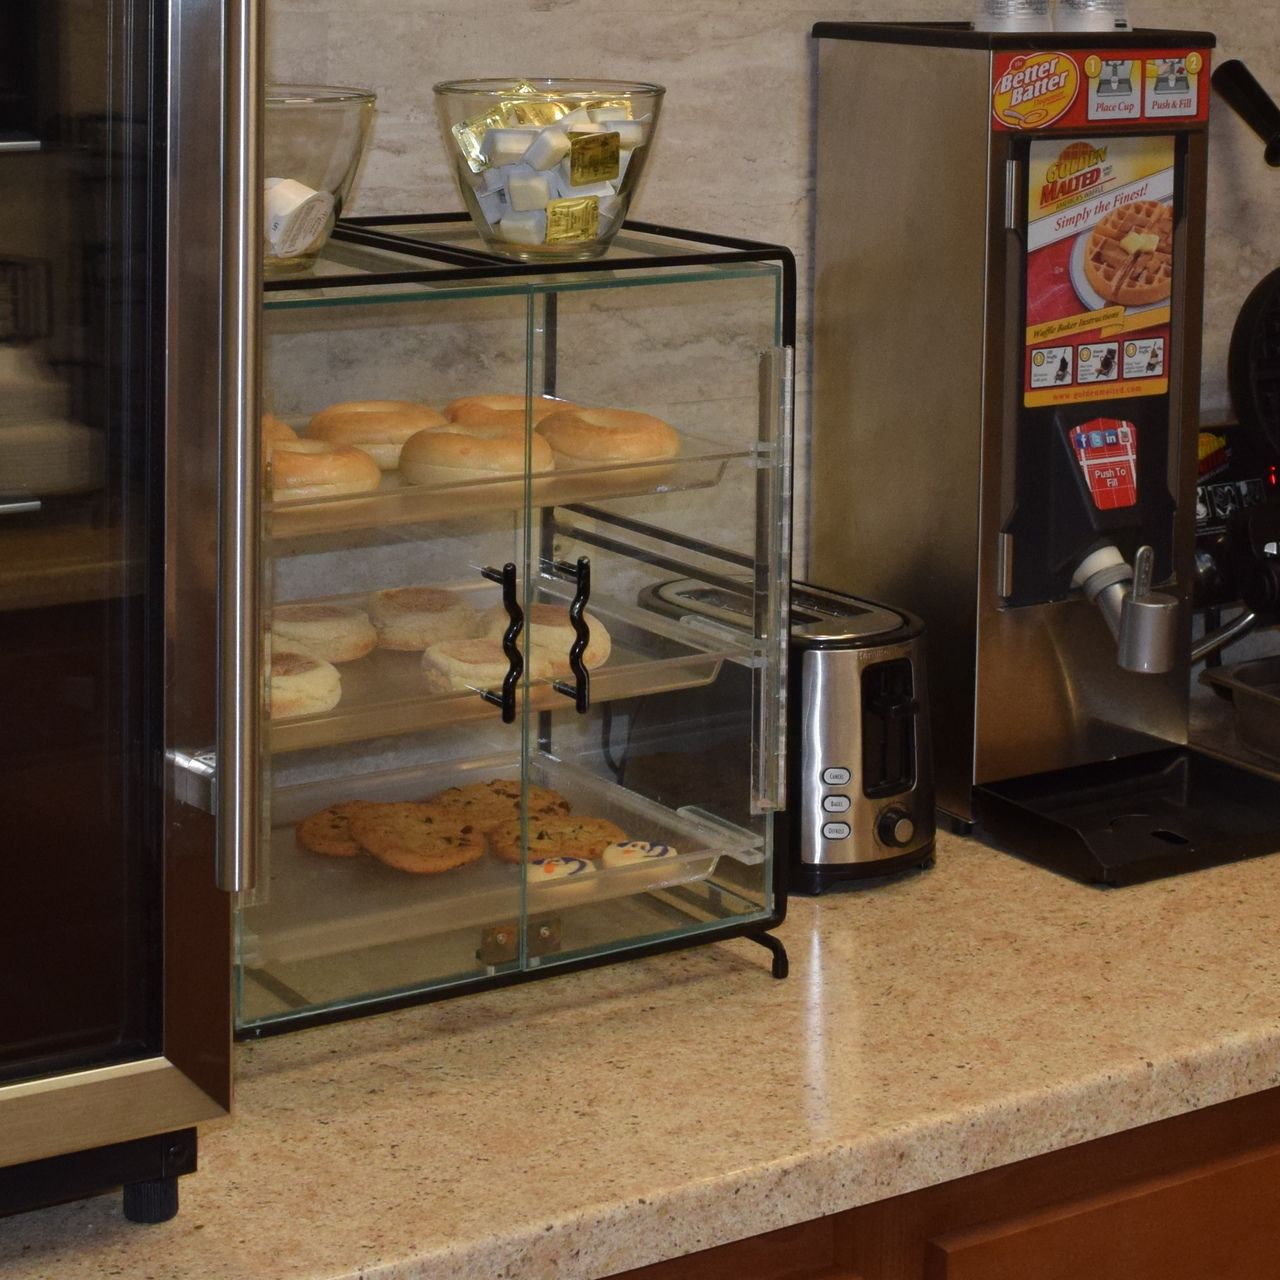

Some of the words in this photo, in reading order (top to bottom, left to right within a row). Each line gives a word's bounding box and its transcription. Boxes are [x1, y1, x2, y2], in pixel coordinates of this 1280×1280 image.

[1000, 56, 1060, 94] Better
[1010, 70, 1069, 108] Batter
[1095, 102, 1117, 113] Place
[1118, 102, 1135, 113] Cup
[1152, 100, 1171, 111] Push
[1179, 99, 1192, 109] Fill
[1046, 145, 1108, 184] GOLDEN
[1040, 167, 1101, 206] MALTED
[1054, 209, 1092, 232] Simply
[1094, 200, 1111, 216] the
[1113, 183, 1149, 208] Finest!
[1095, 468, 1114, 478] Push
[1116, 467, 1126, 477] To
[1107, 478, 1118, 487] Fill
